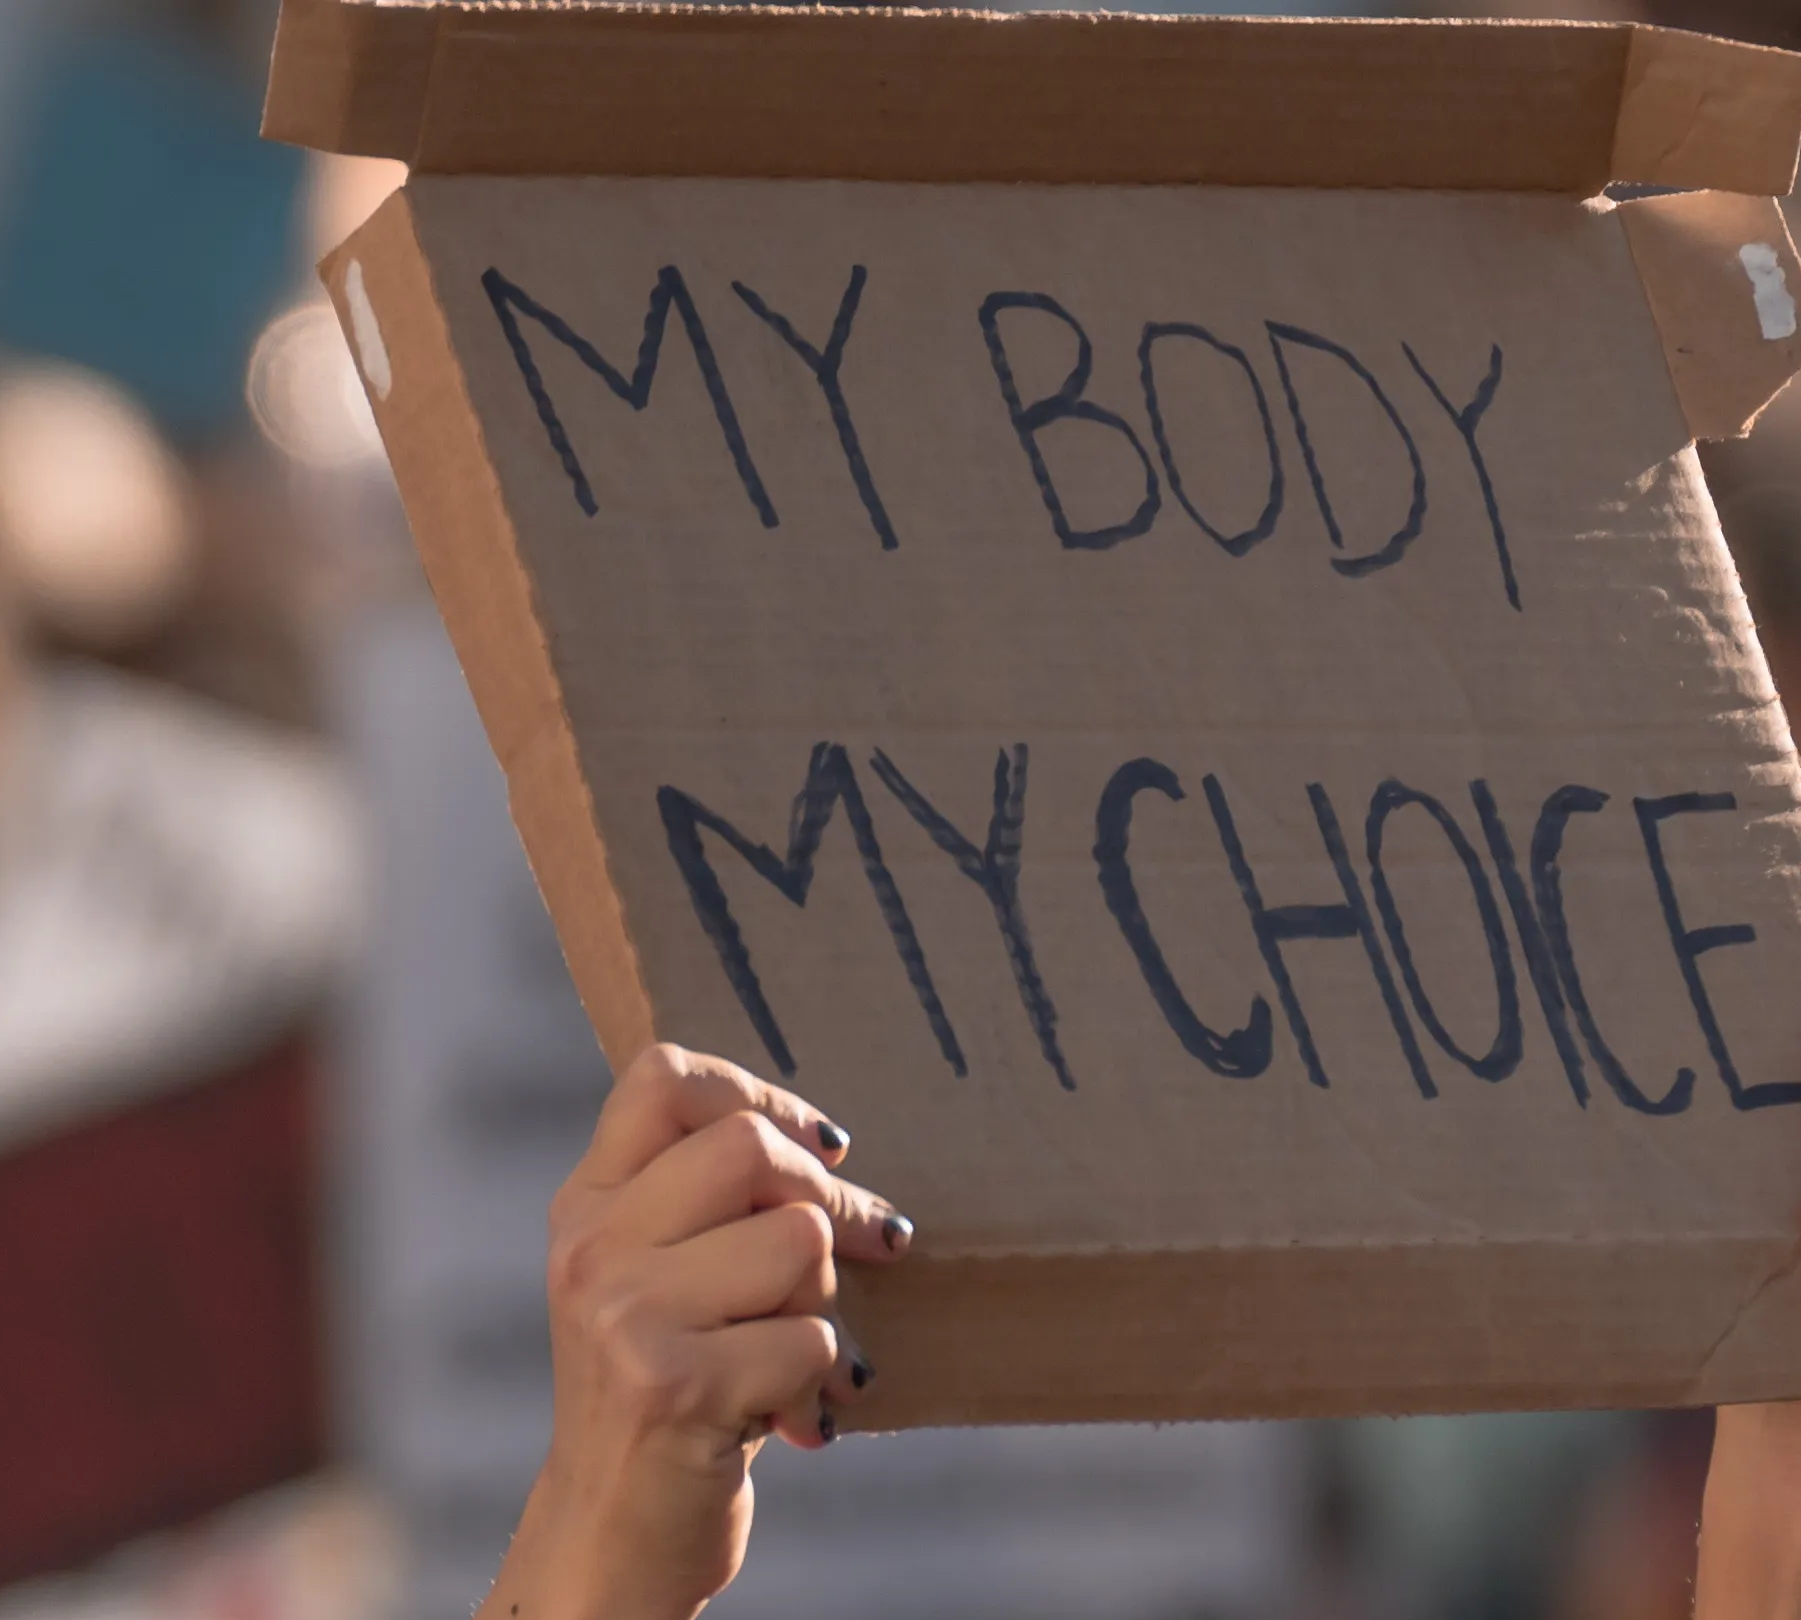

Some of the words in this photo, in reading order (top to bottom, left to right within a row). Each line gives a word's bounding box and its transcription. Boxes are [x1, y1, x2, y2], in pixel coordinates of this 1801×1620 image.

[480, 264, 899, 551] MY
[978, 291, 1522, 612] BODY
[656, 741, 1077, 1091] MY
